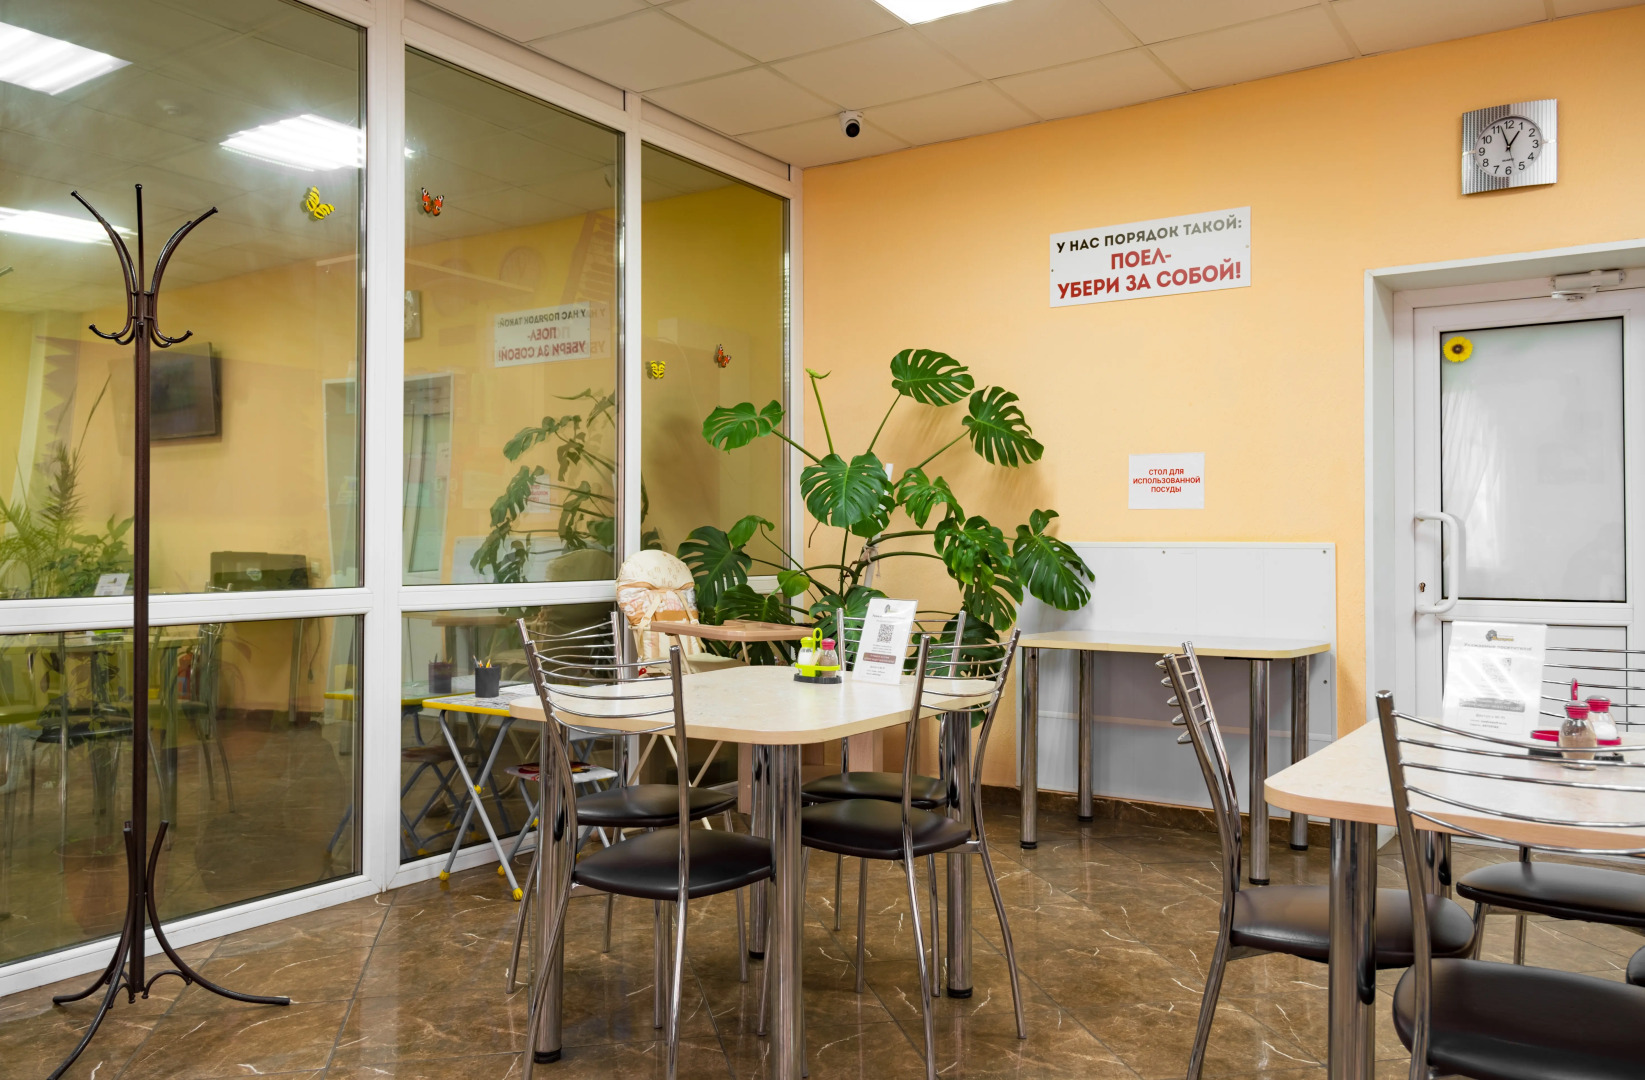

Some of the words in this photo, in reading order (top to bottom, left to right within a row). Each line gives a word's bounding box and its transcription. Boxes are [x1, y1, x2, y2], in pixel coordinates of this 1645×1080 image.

[1504, 120, 1514, 129] 12
[1519, 122, 1523, 130] 1
[1491, 125, 1500, 134] 11
[1528, 128, 1535, 137] 2
[1482, 135, 1492, 144] 10
[1532, 140, 1539, 148] 3
[1479, 147, 1485, 156] 9
[1528, 152, 1534, 160] 4
[1482, 158, 1489, 167] 8
[1518, 162, 1525, 170] 5
[1493, 165, 1499, 174] 7
[1505, 166, 1512, 175] 6
[1056, 242, 1066, 253] У
[1070, 238, 1100, 252] НАС
[1104, 226, 1179, 246] ПОРЯДОК
[1183, 214, 1242, 236] ТАКОЙ:
[1111, 248, 1172, 270] ПОЕЛ-
[1057, 277, 1120, 300] УБЕРИ
[1126, 273, 1152, 292] ЗА
[1156, 258, 1241, 288] СОБОЙ!
[1168, 468, 1184, 476] ДЛЯ
[1132, 476, 1200, 484] ИСПОЛЬЗОВАННОЙ
